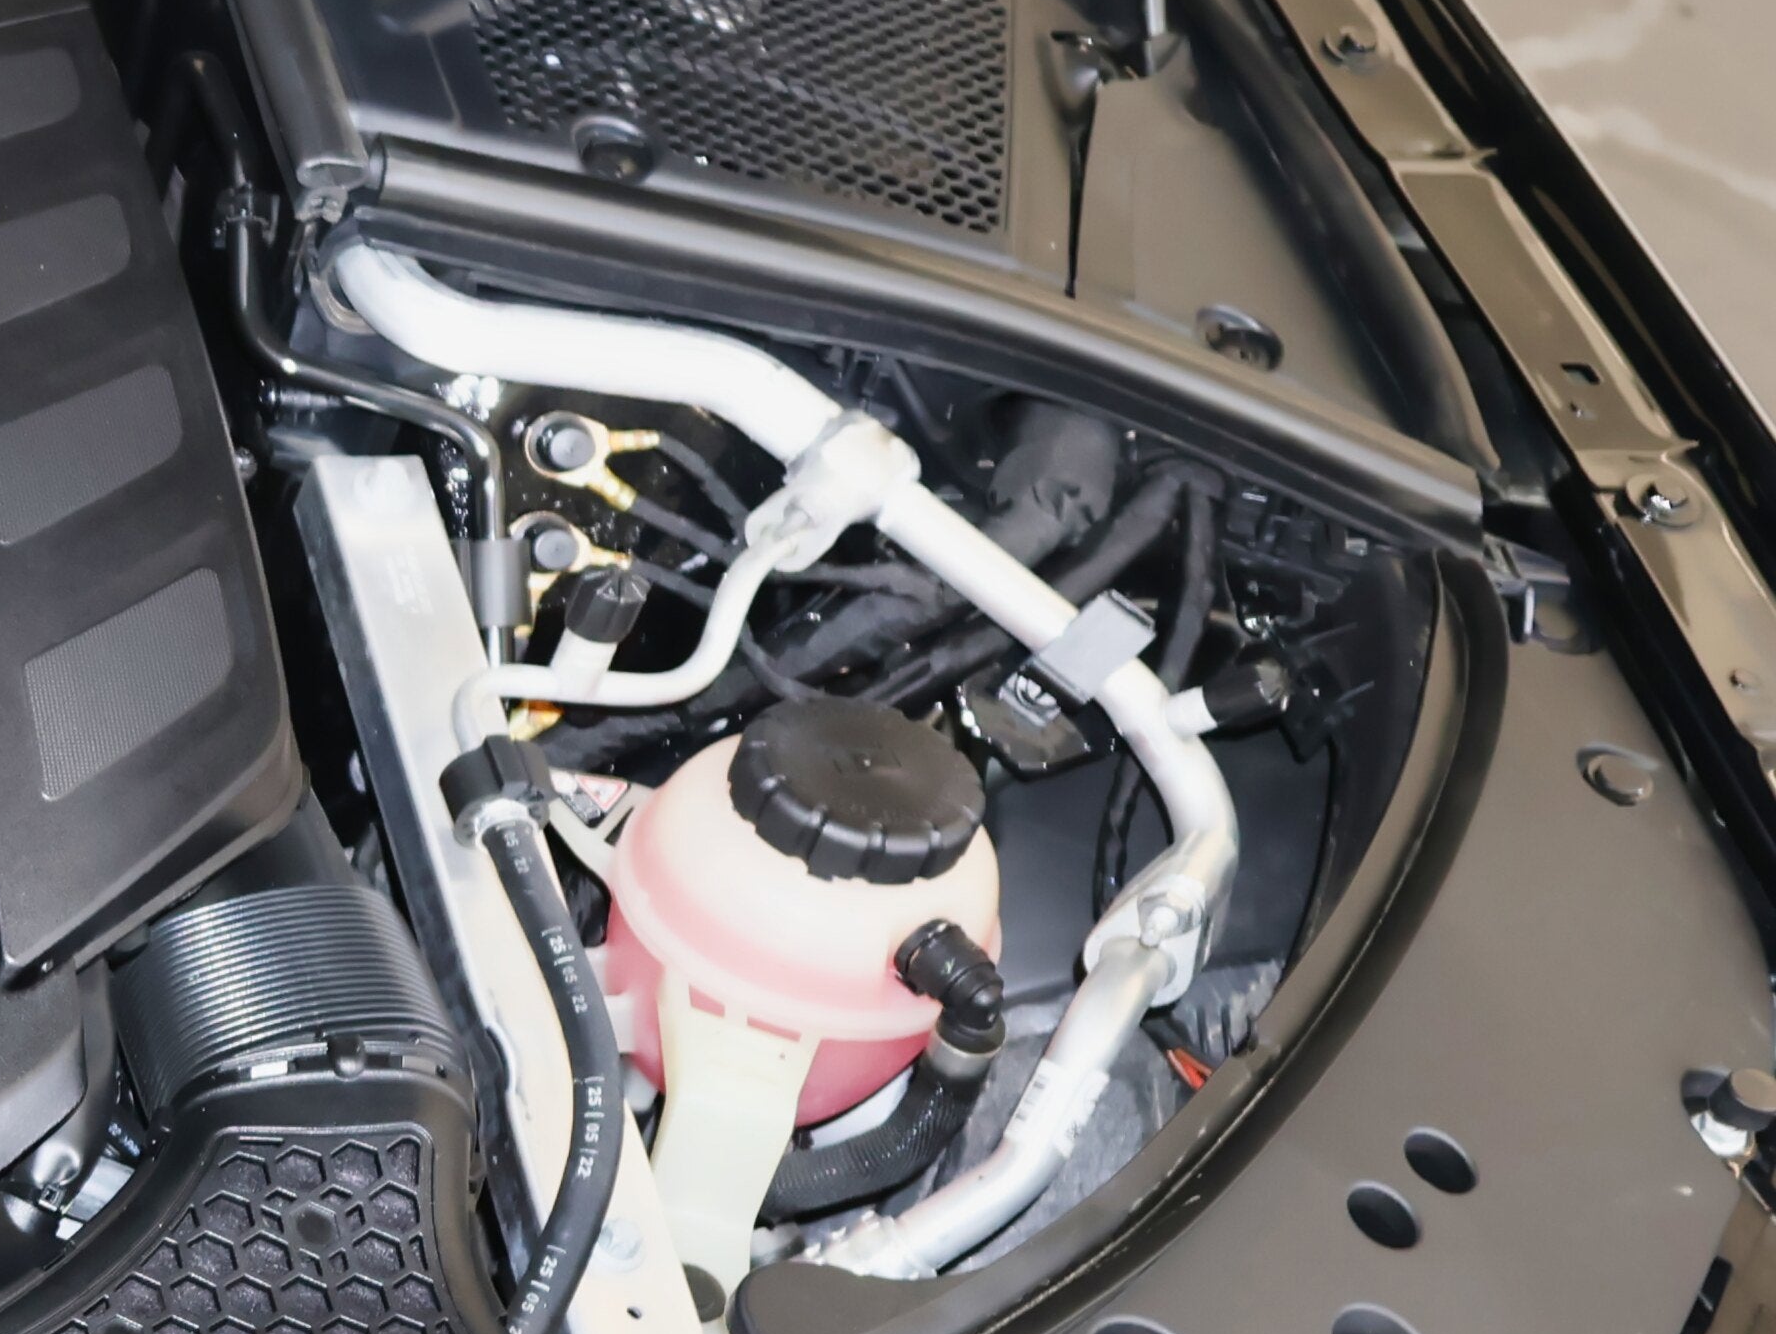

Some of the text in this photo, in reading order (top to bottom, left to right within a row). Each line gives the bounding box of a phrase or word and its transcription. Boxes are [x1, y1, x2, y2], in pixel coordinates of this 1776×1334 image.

[572, 994, 588, 1014] 22
[578, 1087, 601, 1178] 25 05 22
[539, 1255, 558, 1279] 25
[521, 1291, 540, 1314] 05
